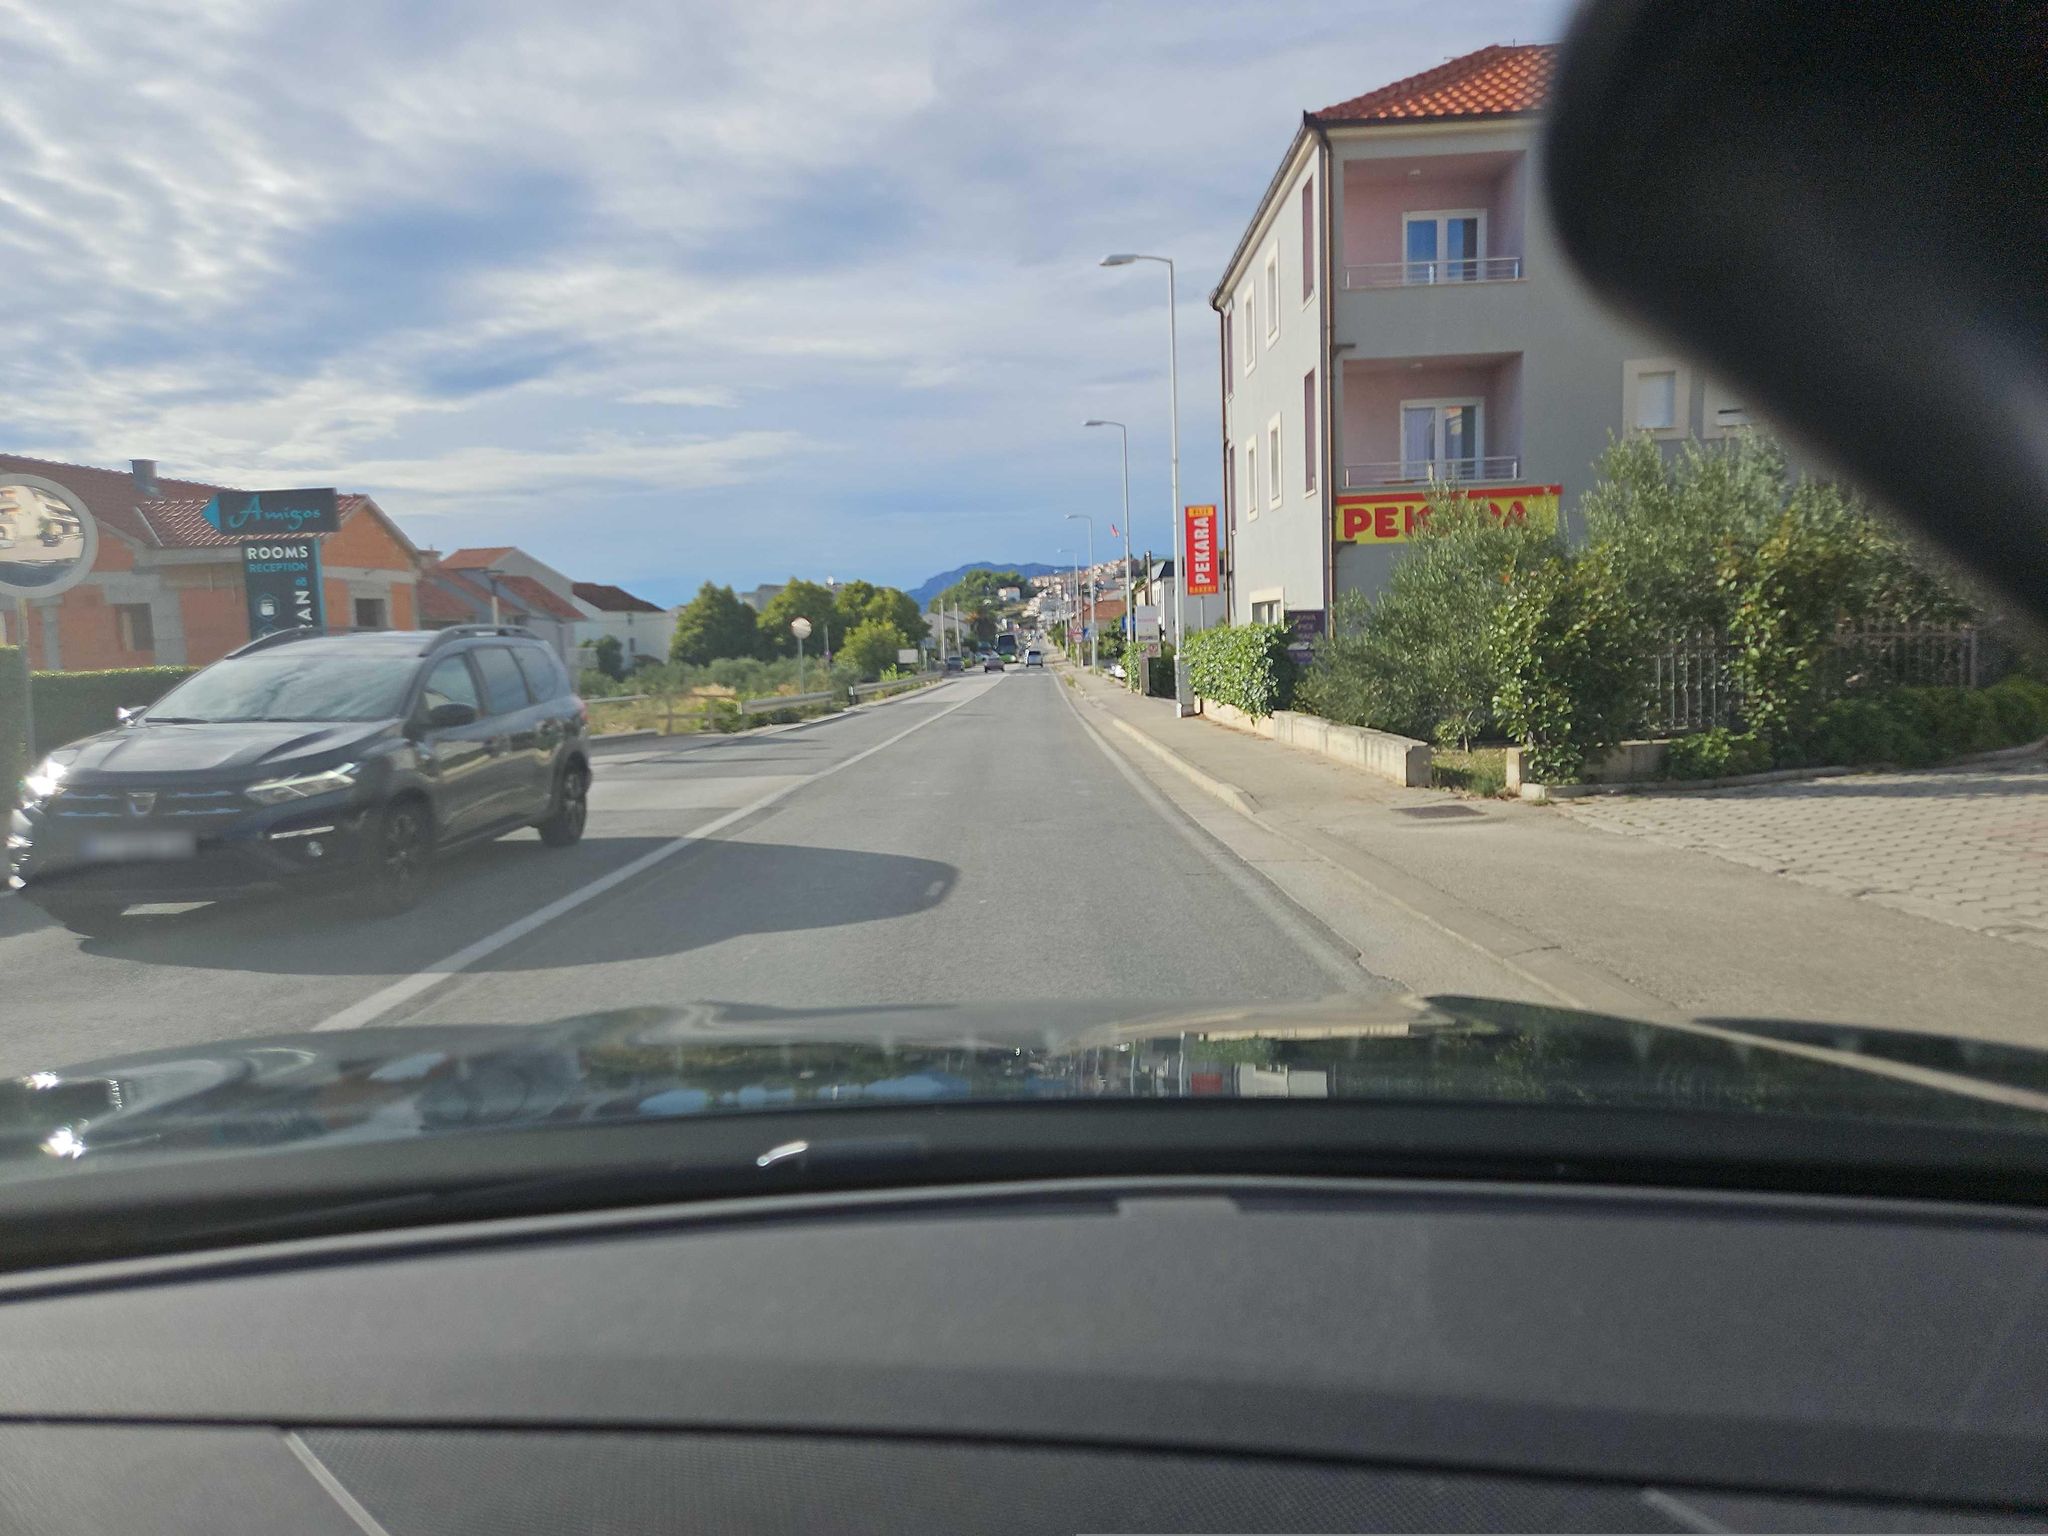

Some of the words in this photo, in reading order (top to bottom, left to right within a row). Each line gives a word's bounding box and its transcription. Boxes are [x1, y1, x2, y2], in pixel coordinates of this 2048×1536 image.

[228, 495, 321, 530] Amigos
[247, 546, 309, 560] ROOMS
[1193, 516, 1210, 585] PEKARA
[248, 562, 309, 573] RECEPTION
